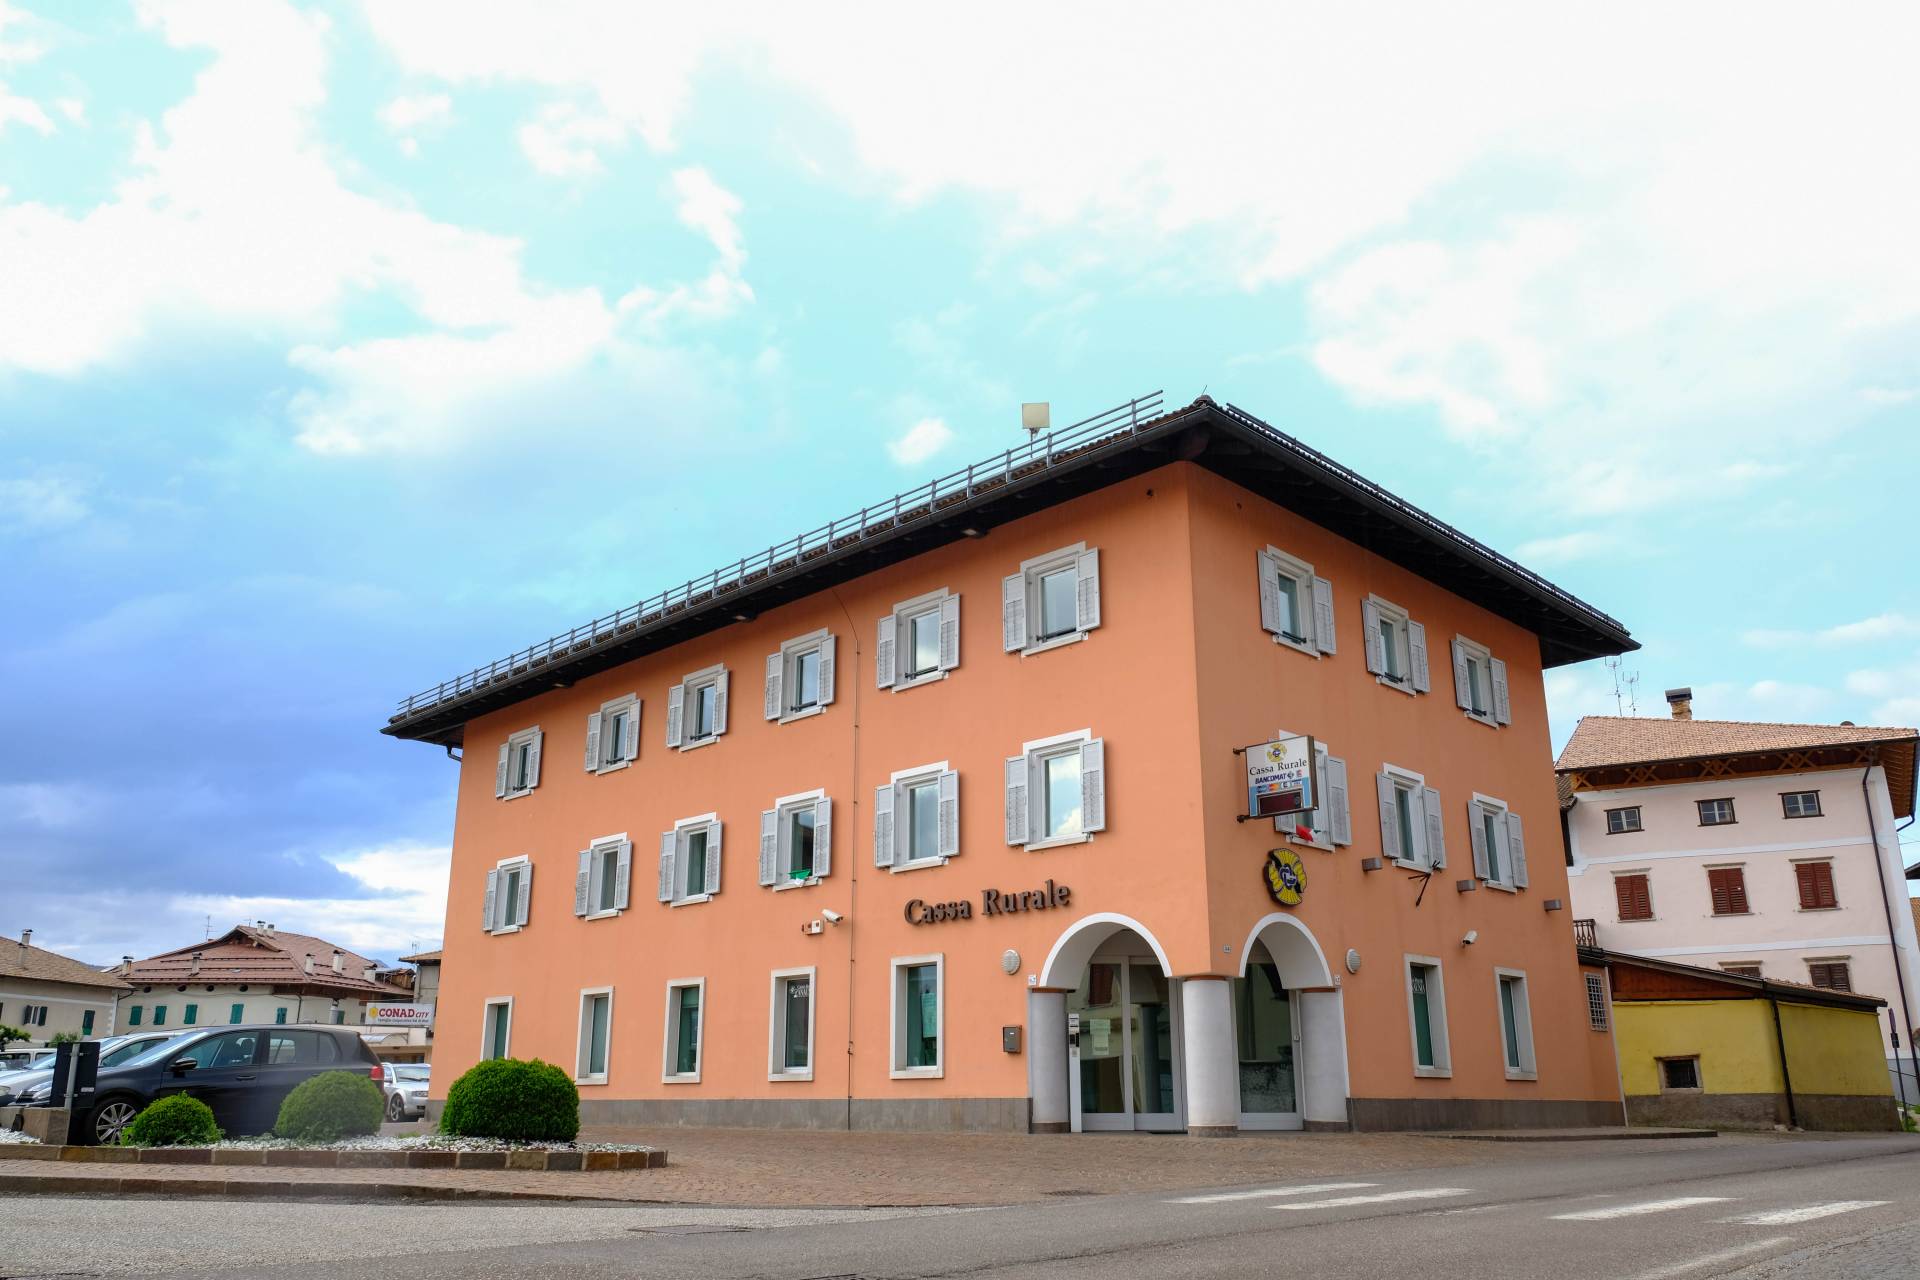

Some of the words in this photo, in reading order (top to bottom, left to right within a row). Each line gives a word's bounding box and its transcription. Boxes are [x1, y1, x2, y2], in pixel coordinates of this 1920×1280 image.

[1249, 766, 1274, 776] Cassa
[1277, 758, 1308, 771] Rurale
[1255, 772, 1287, 785] BANCOMAT
[904, 898, 973, 926] Cassa
[981, 878, 1072, 918] Rurale
[378, 1008, 415, 1018] CONAD
